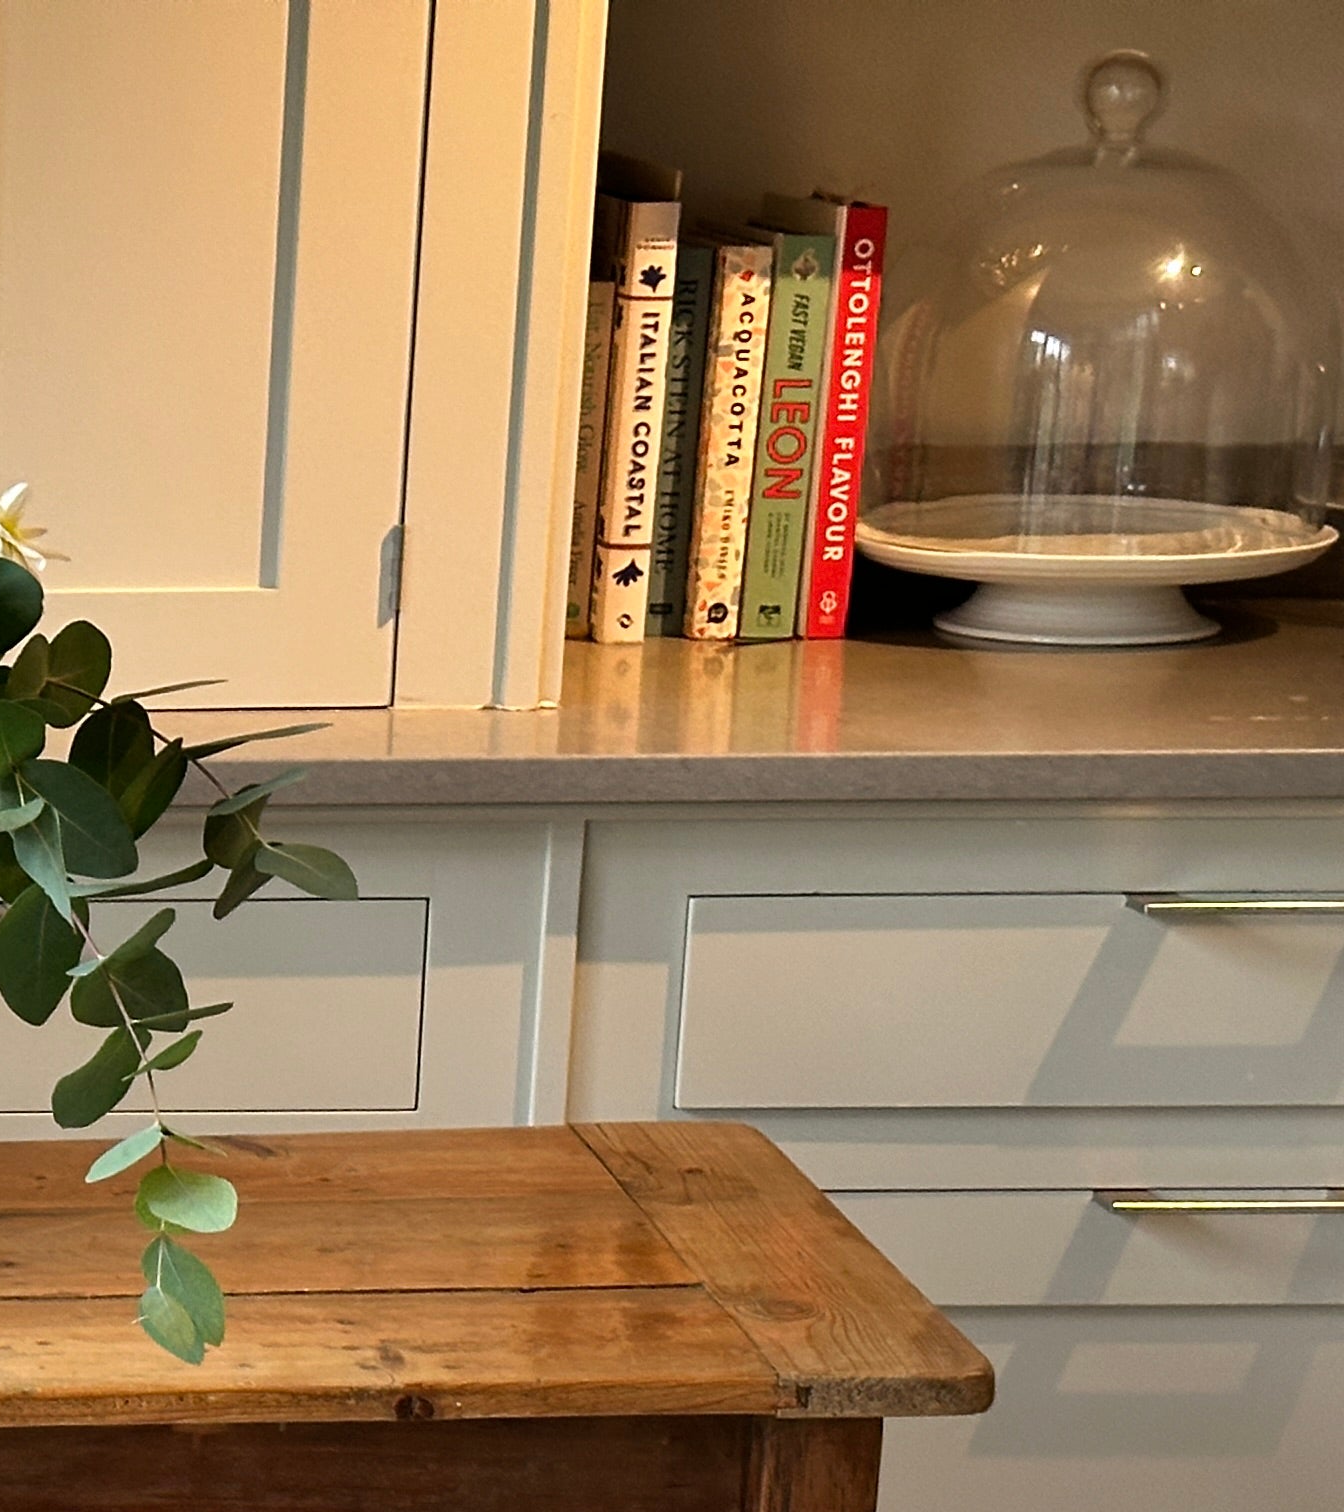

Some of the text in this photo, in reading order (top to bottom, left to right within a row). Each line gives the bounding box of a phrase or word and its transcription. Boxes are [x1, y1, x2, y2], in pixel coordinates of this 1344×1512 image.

[622, 312, 661, 537] ITALIAN COASTAL
[654, 279, 698, 574] RICK STEIN AT HOME
[725, 293, 756, 466] ACQUACOTTA
[787, 293, 810, 371] FAST VEGAN
[822, 238, 875, 561] OTTOLENGHI FLAVOUR
[762, 378, 814, 500] LEON
